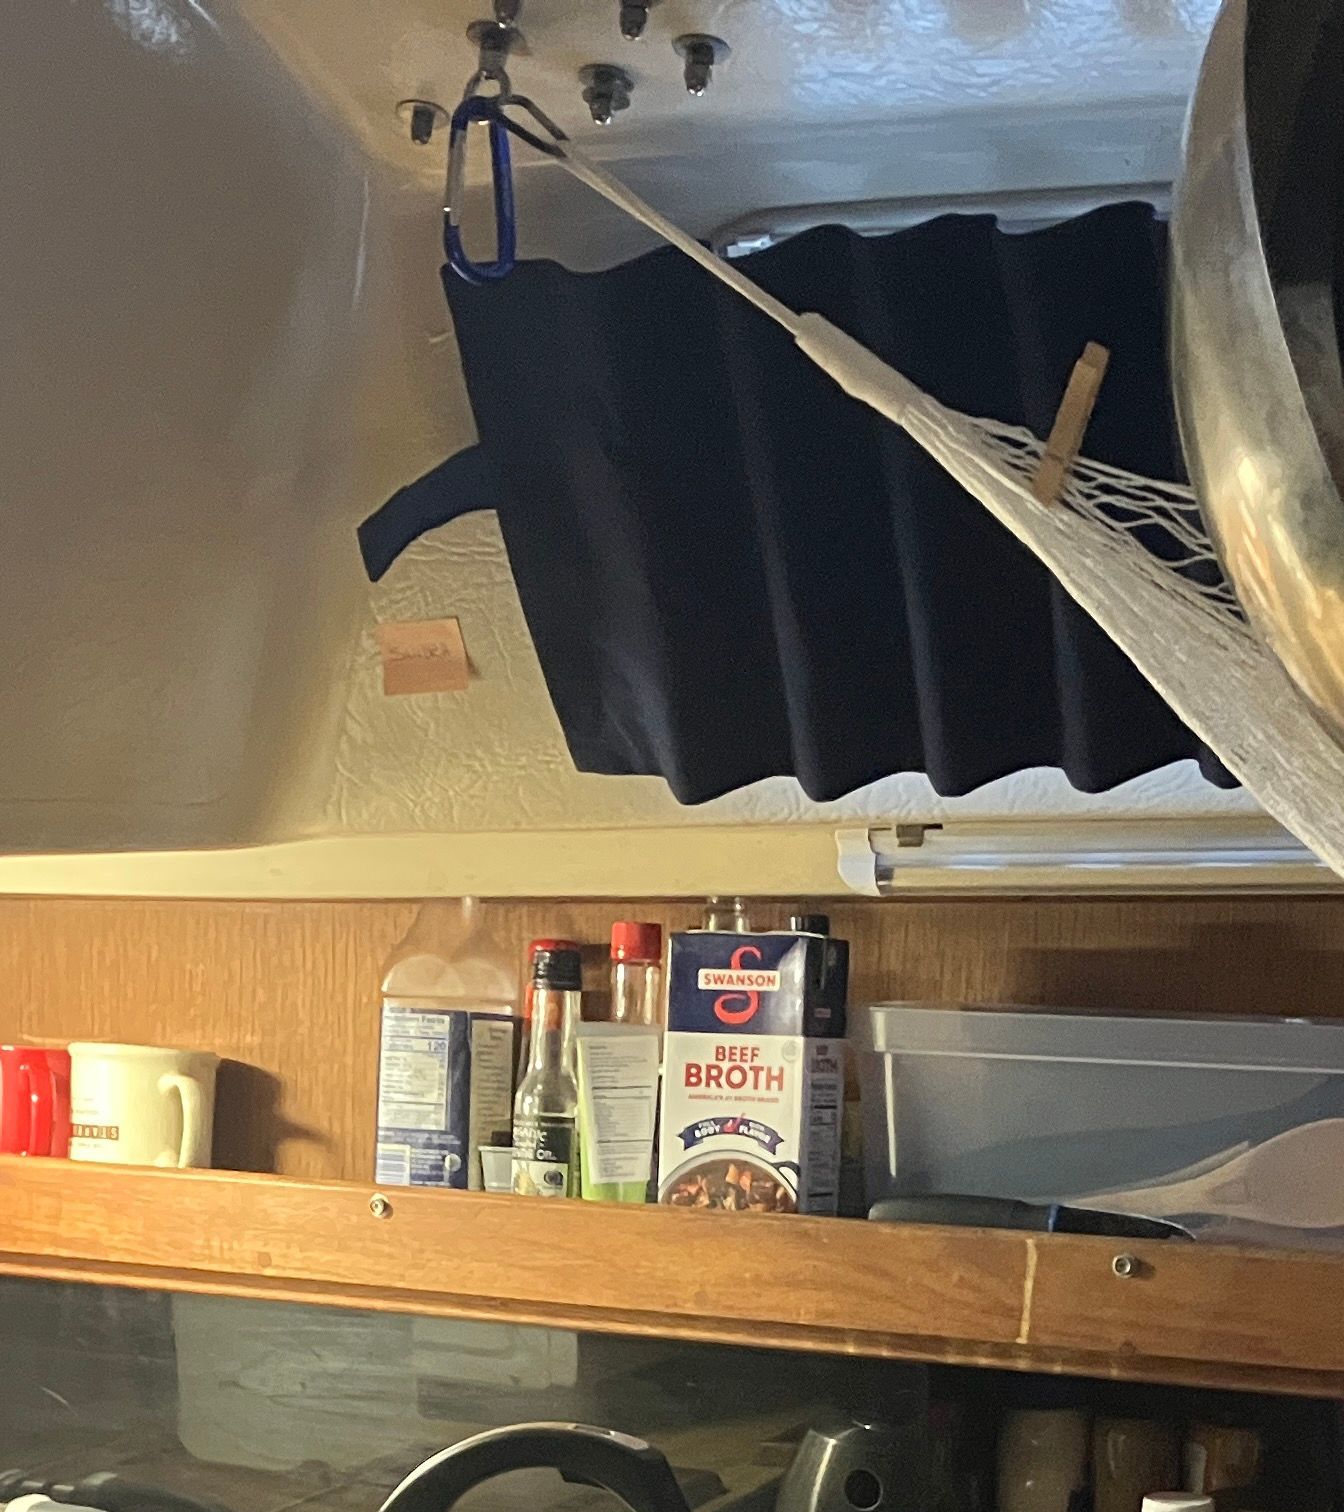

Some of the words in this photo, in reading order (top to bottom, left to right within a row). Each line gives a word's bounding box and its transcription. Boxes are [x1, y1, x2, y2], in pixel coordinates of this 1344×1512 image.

[703, 972, 777, 987] SWANSON
[714, 1044, 761, 1063] BEEF
[684, 1063, 785, 1092] BROTH
